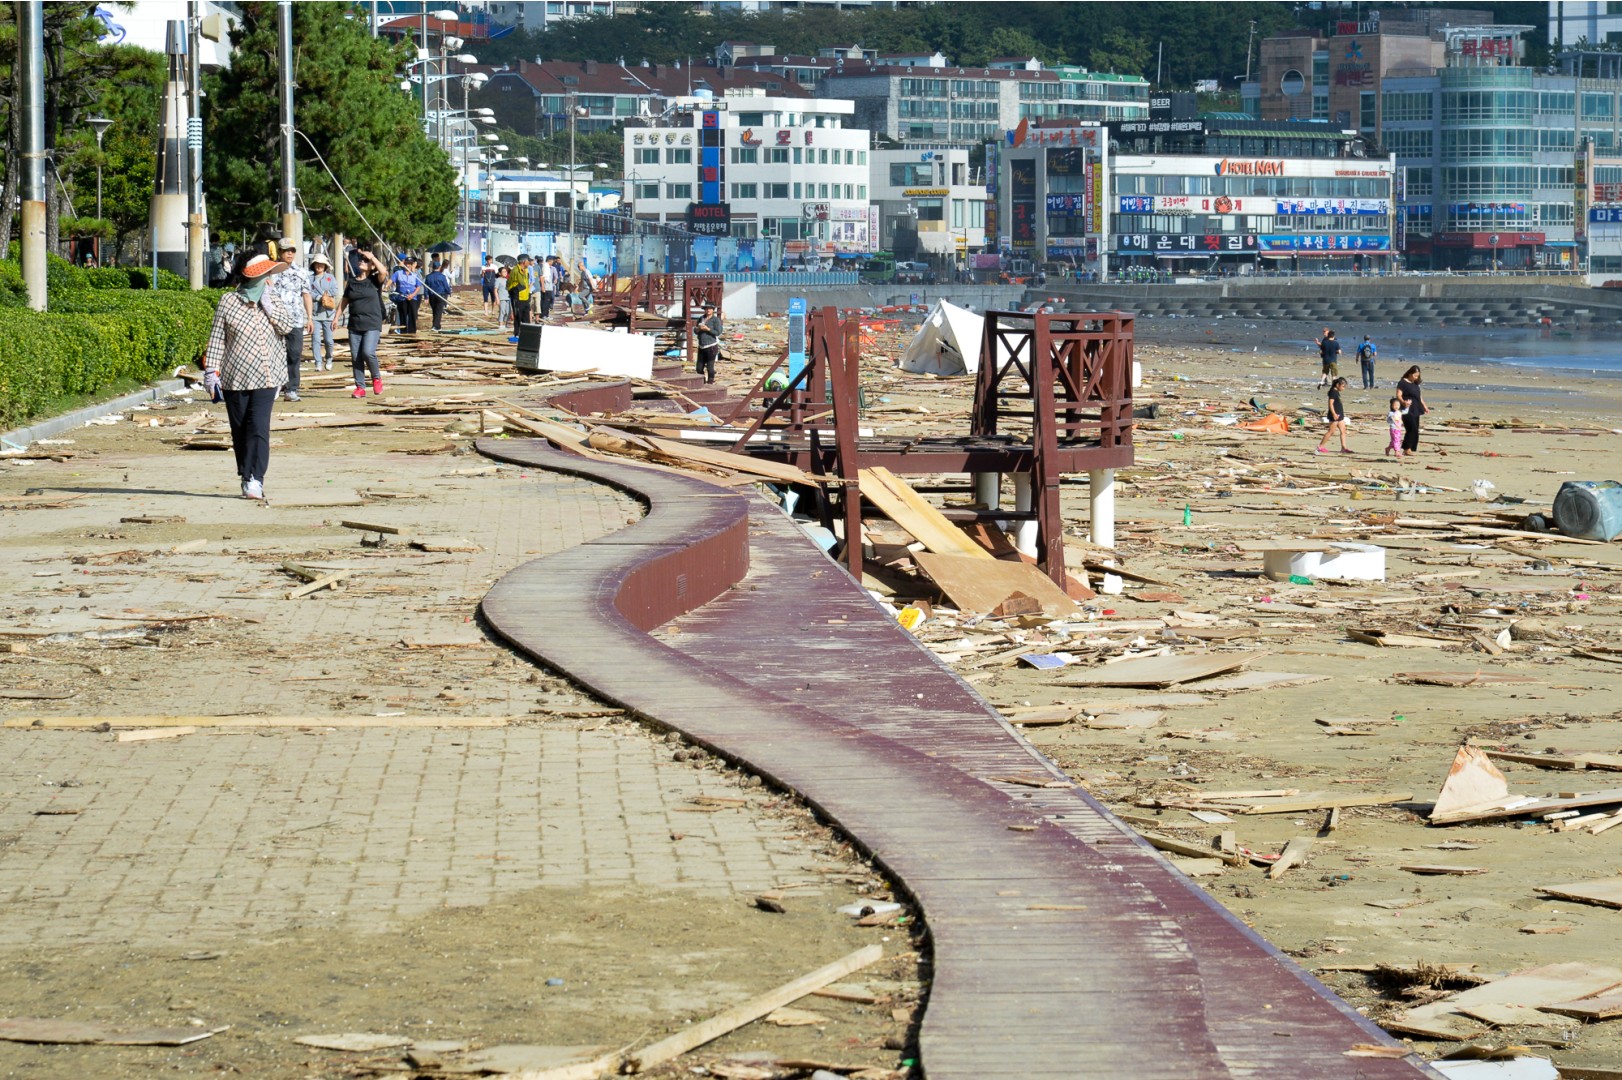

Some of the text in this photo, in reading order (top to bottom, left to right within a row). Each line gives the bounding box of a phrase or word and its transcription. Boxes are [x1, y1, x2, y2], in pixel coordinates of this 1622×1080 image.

[1152, 98, 1170, 106] BEER
[1228, 160, 1284, 175] HOTEL NAVI
[694, 207, 726, 217] MOTEL
[1303, 236, 1349, 249] 부산횟집
